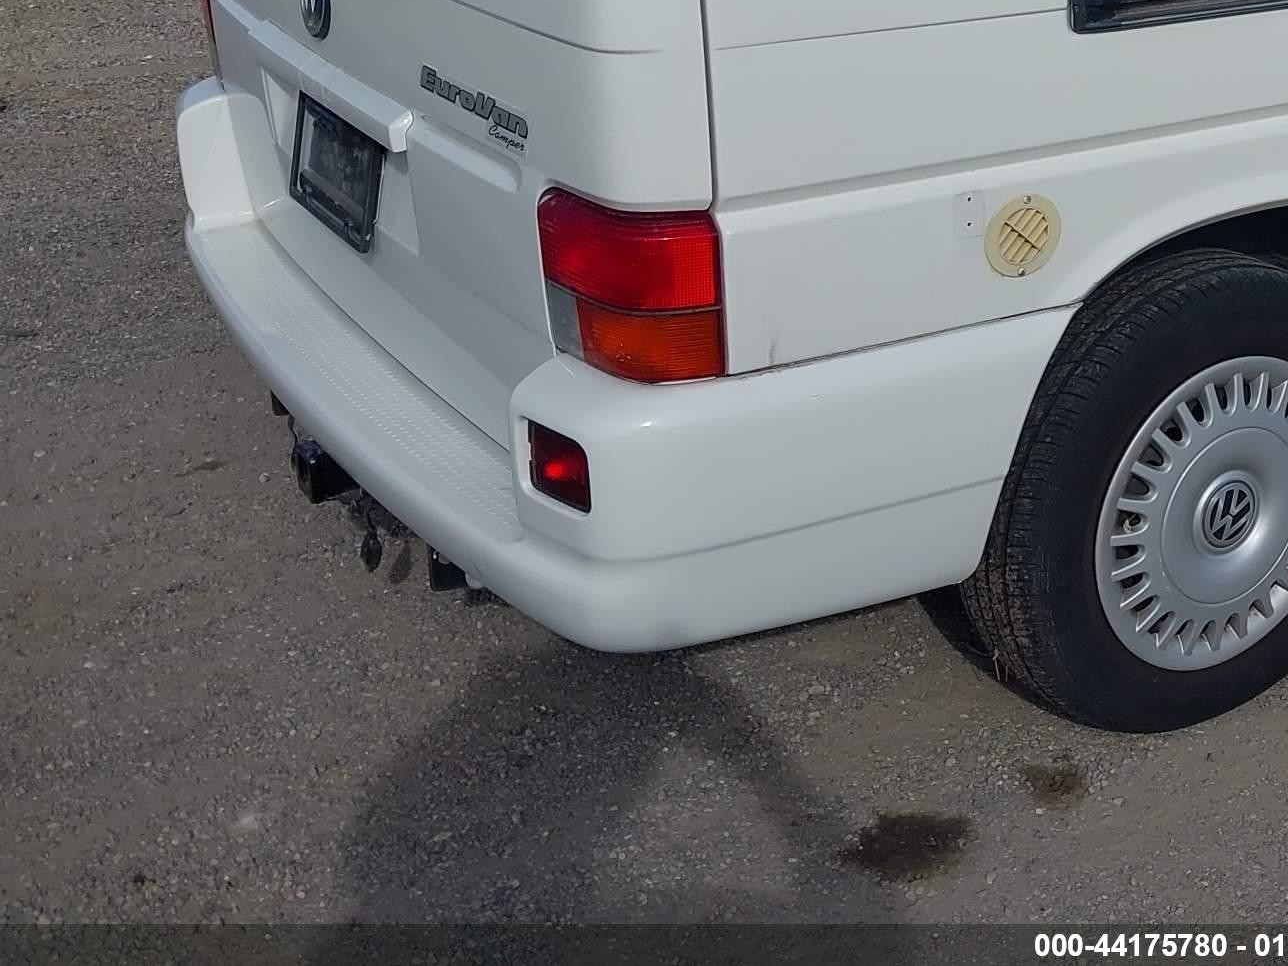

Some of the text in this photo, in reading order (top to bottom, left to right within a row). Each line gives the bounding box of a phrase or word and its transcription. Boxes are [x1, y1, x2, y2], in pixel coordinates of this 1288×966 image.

[420, 65, 528, 139] EuroVan
[488, 124, 525, 151] Camper
[1204, 482, 1255, 548] VW
